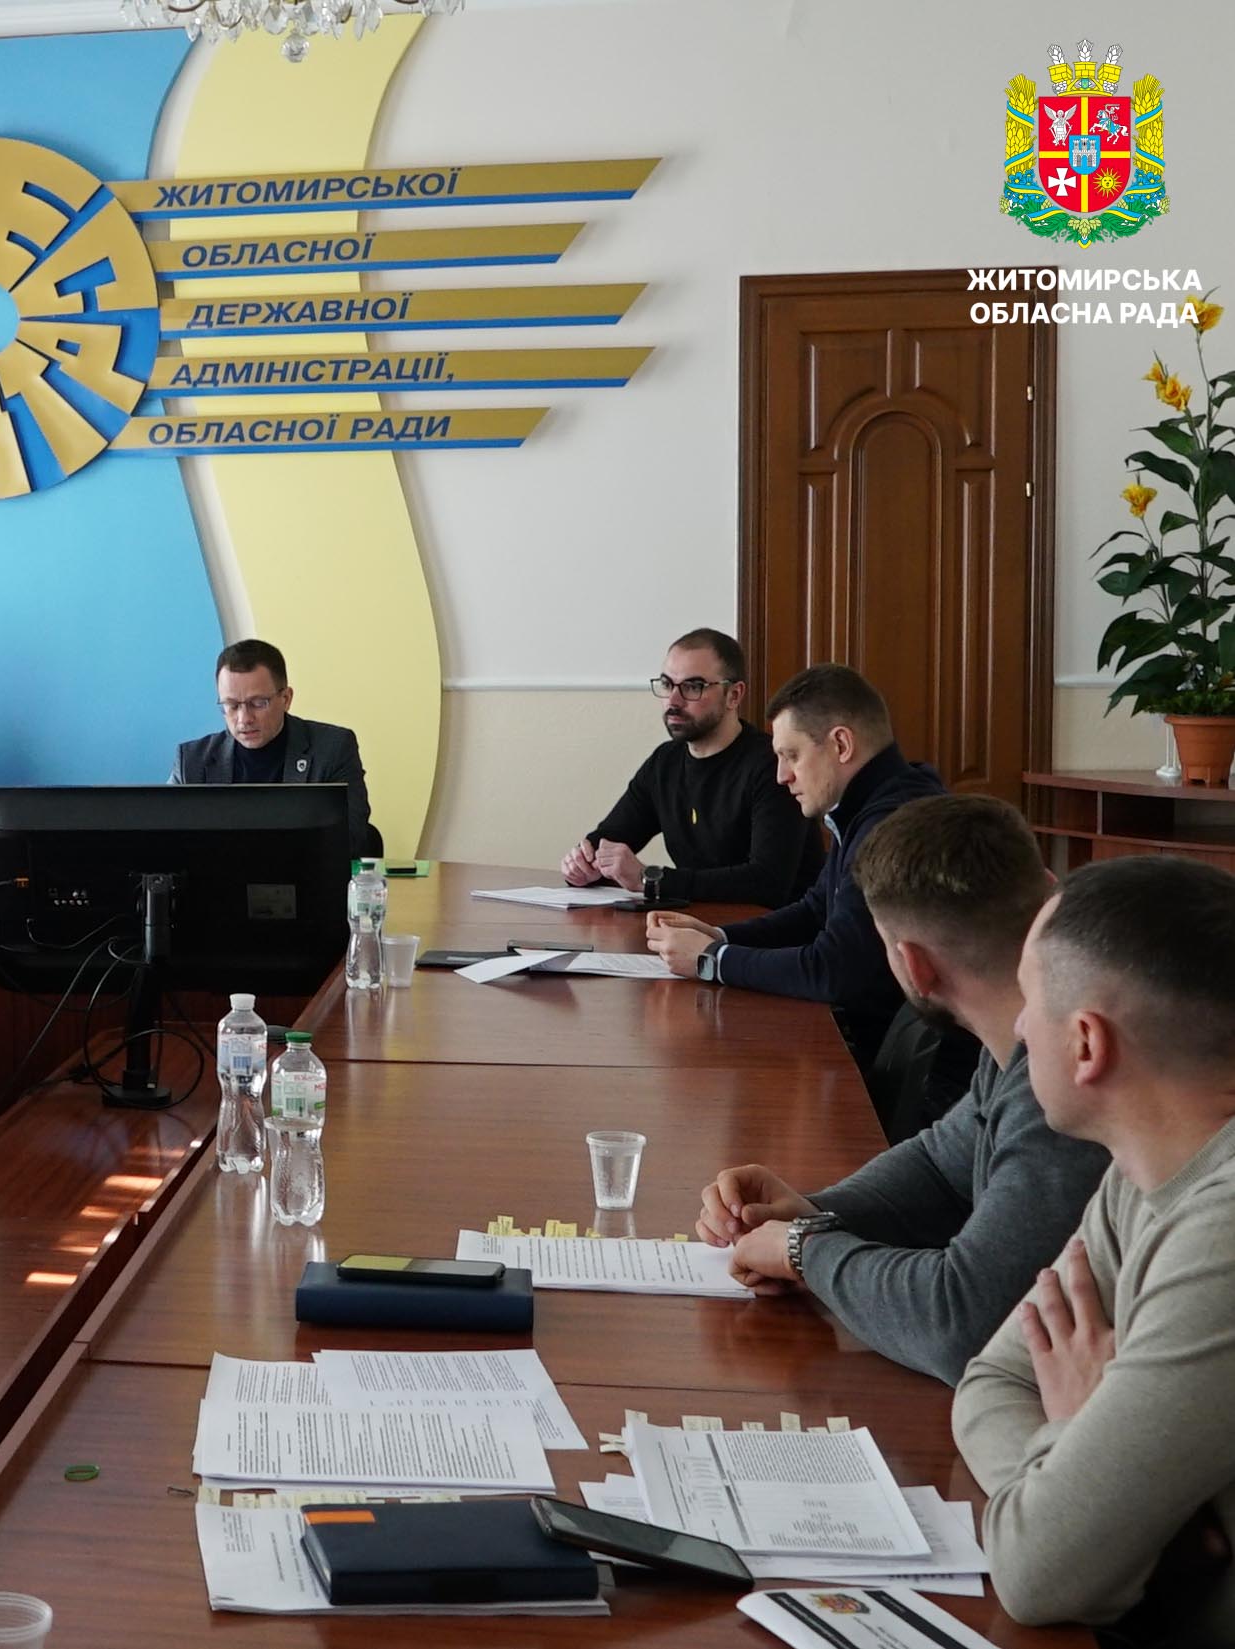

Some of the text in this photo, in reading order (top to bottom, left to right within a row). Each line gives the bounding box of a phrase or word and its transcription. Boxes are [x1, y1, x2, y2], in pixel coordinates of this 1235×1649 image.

[156, 168, 461, 208] ЖИТОМИРСЬКОЇ
[182, 233, 375, 268] ОБЛАСНОЇ
[188, 292, 412, 329] ДЕРЖАВНОЇ
[171, 352, 455, 386] АДМІНІСТРАЦІЇ,
[149, 413, 452, 444] ОБЛАСНОЇ РАДИ
